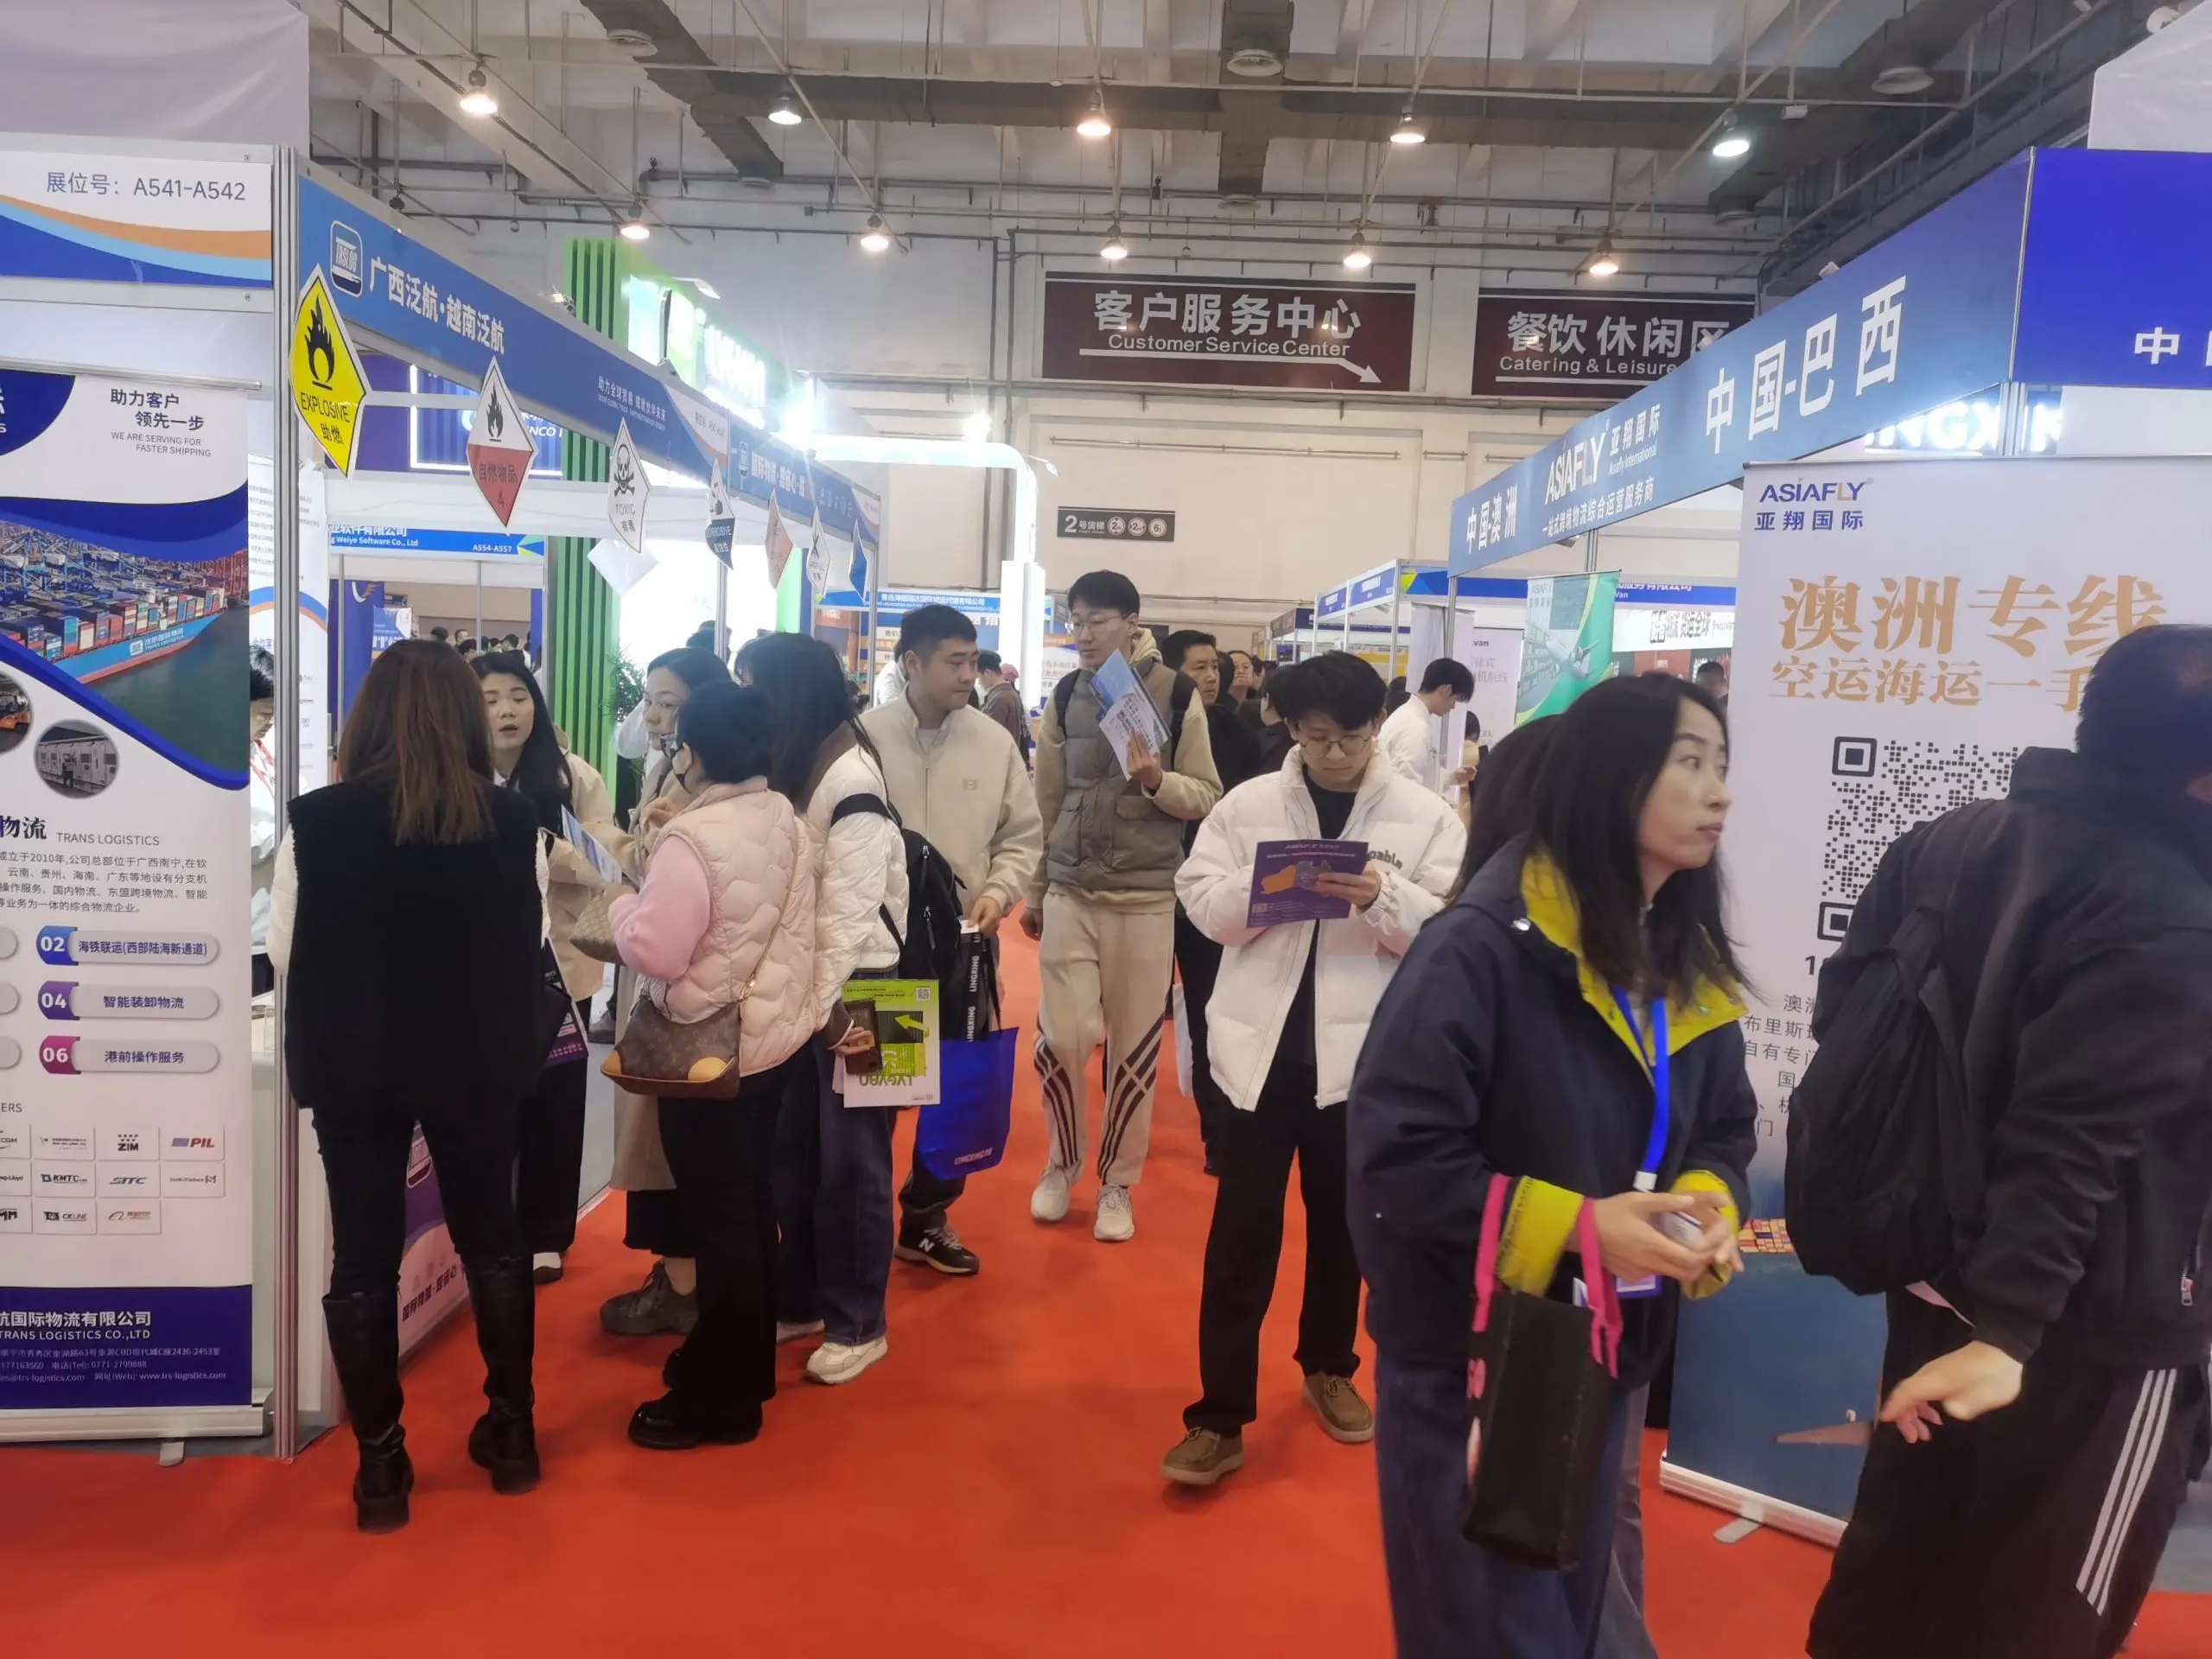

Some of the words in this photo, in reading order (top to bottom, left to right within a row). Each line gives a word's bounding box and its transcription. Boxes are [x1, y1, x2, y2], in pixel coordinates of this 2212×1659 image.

[133, 177, 246, 202] A541-A542
[369, 256, 505, 356] 广西泛航·越南泛航
[1094, 291, 1362, 340] 客户服务中心
[1108, 334, 1204, 356] Customer
[1205, 337, 1281, 359] Service
[1282, 340, 1351, 359] Center
[2133, 327, 2212, 366] 中
[1498, 354, 1580, 376] Catering
[1586, 356, 1600, 375] &
[1706, 275, 1907, 456] 中国-巴西
[110, 389, 180, 409] 助力客户
[300, 392, 351, 423] EXPLOSIVE
[136, 410, 205, 431] 领先一步
[1610, 404, 1661, 456] 亚翔国际
[127, 433, 143, 442] ARE
[146, 434, 181, 444] SERVING
[136, 443, 167, 454] FASTER
[169, 445, 211, 457] SHIPPING
[1544, 439, 1609, 506] ASIAFLY
[1758, 480, 1865, 503] ASIAFLY
[615, 503, 635, 515] TOXIC
[1465, 484, 1518, 554] 中国-澳洲
[1754, 510, 1864, 531] 亚翔国际
[359, 537, 390, 546] Software
[473, 544, 512, 553] A554-A557
[1781, 575, 2167, 658] 澳洲专线
[0, 815, 47, 839] 物流
[57, 832, 95, 844] TRANS
[98, 834, 160, 846] LOGISTICS
[41, 936, 65, 952] 02
[79, 940, 207, 957] 海铁联运(西部陆海新通道)
[969, 956, 979, 992] LINGXING
[41, 993, 67, 1009] 04
[103, 995, 184, 1009] 智能装卸物流
[42, 1047, 68, 1064] 06
[104, 1050, 185, 1064] 港前操作服务
[190, 1138, 215, 1147] PIL
[53, 1174, 79, 1183] KMTC
[39, 1331, 101, 1340] LOGISTICS
[105, 1330, 150, 1340] CO.,LTD
